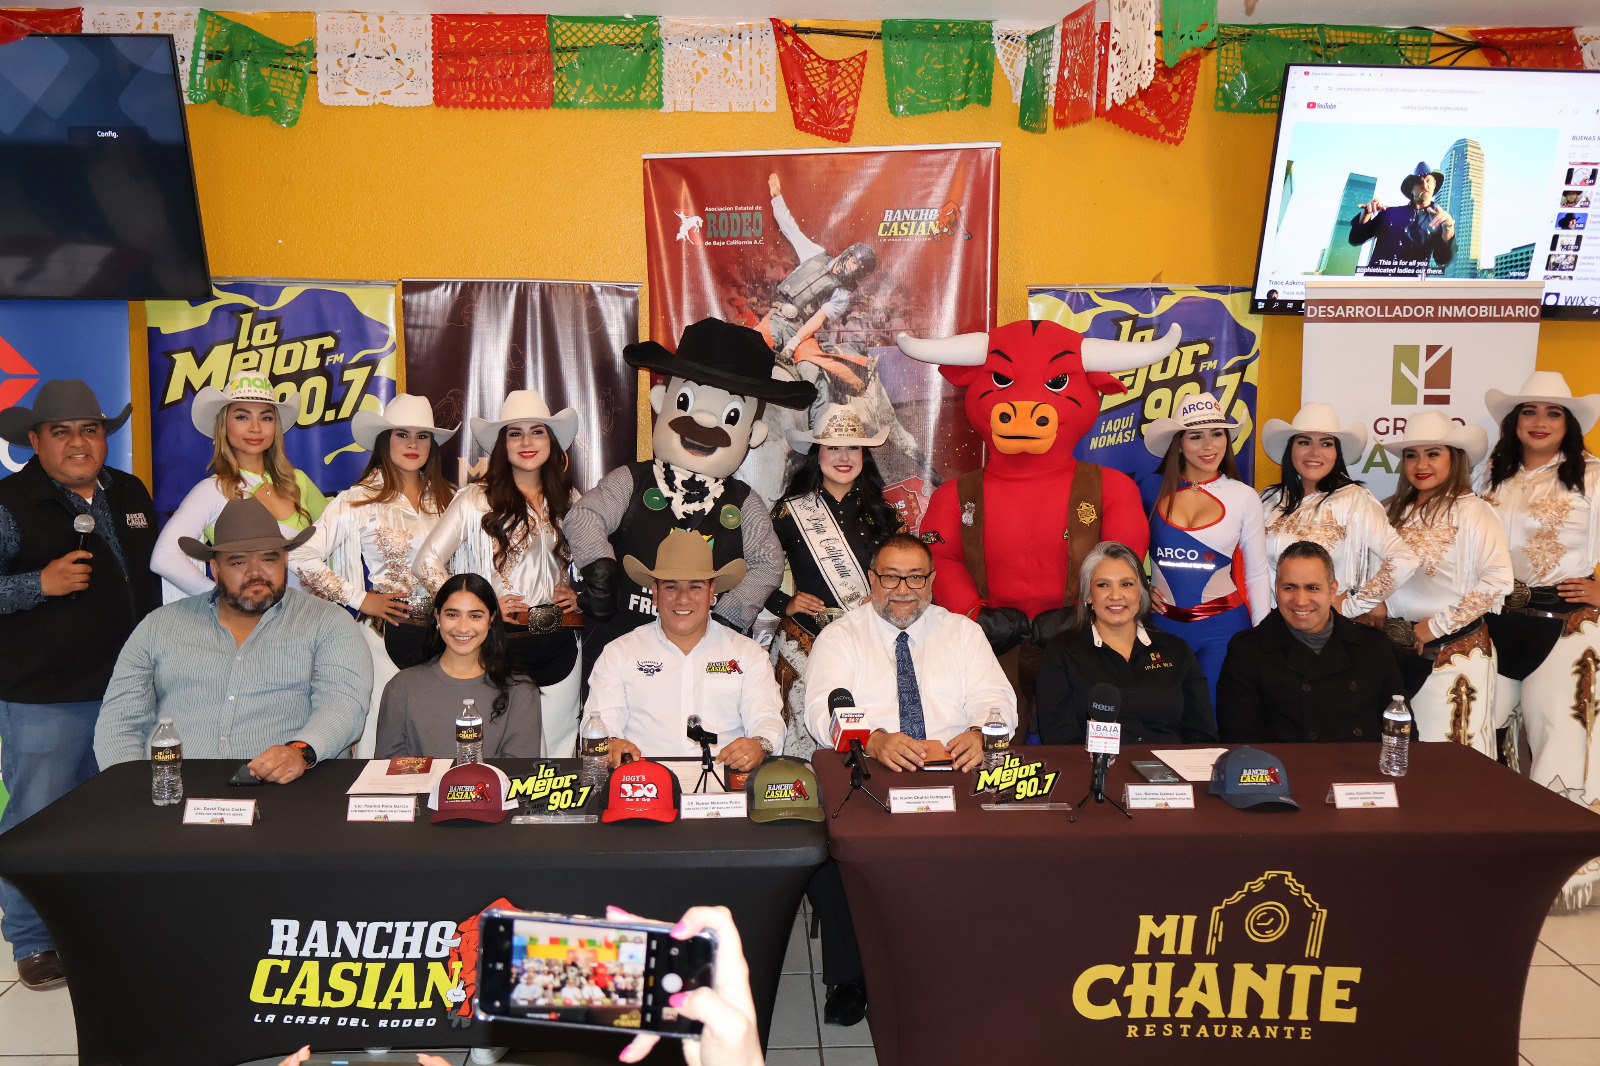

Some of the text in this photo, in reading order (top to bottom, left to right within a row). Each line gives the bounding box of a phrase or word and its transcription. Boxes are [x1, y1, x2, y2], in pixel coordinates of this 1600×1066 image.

[706, 212, 763, 238] RODEO
[883, 209, 939, 222] RANCHO
[878, 220, 940, 236] CASIAN
[1307, 305, 1540, 318] DESARROLLADOR INMOBILIARIO
[237, 312, 278, 350] la
[325, 353, 344, 366] FM
[1199, 360, 1218, 372] FM
[1182, 401, 1213, 416] ARCO
[1100, 413, 1135, 433] ¡AQUÍ
[1089, 429, 1136, 450] NOMÁS!
[1157, 547, 1199, 561] ARCO
[538, 764, 555, 779] la
[1004, 754, 1020, 769] la
[976, 762, 1042, 790] Mejor
[508, 774, 577, 800] Mejor
[1015, 773, 1056, 800] 90.7
[548, 786, 591, 811] 90.7
[268, 918, 458, 959] RANCHO
[1134, 914, 1198, 955] MI
[250, 959, 463, 1010] CASIAN
[1072, 962, 1362, 1023] CHANTE
[254, 1014, 437, 1028] LA CASA DEL RODEO
[1126, 1024, 1312, 1040] RESTAURANTE
